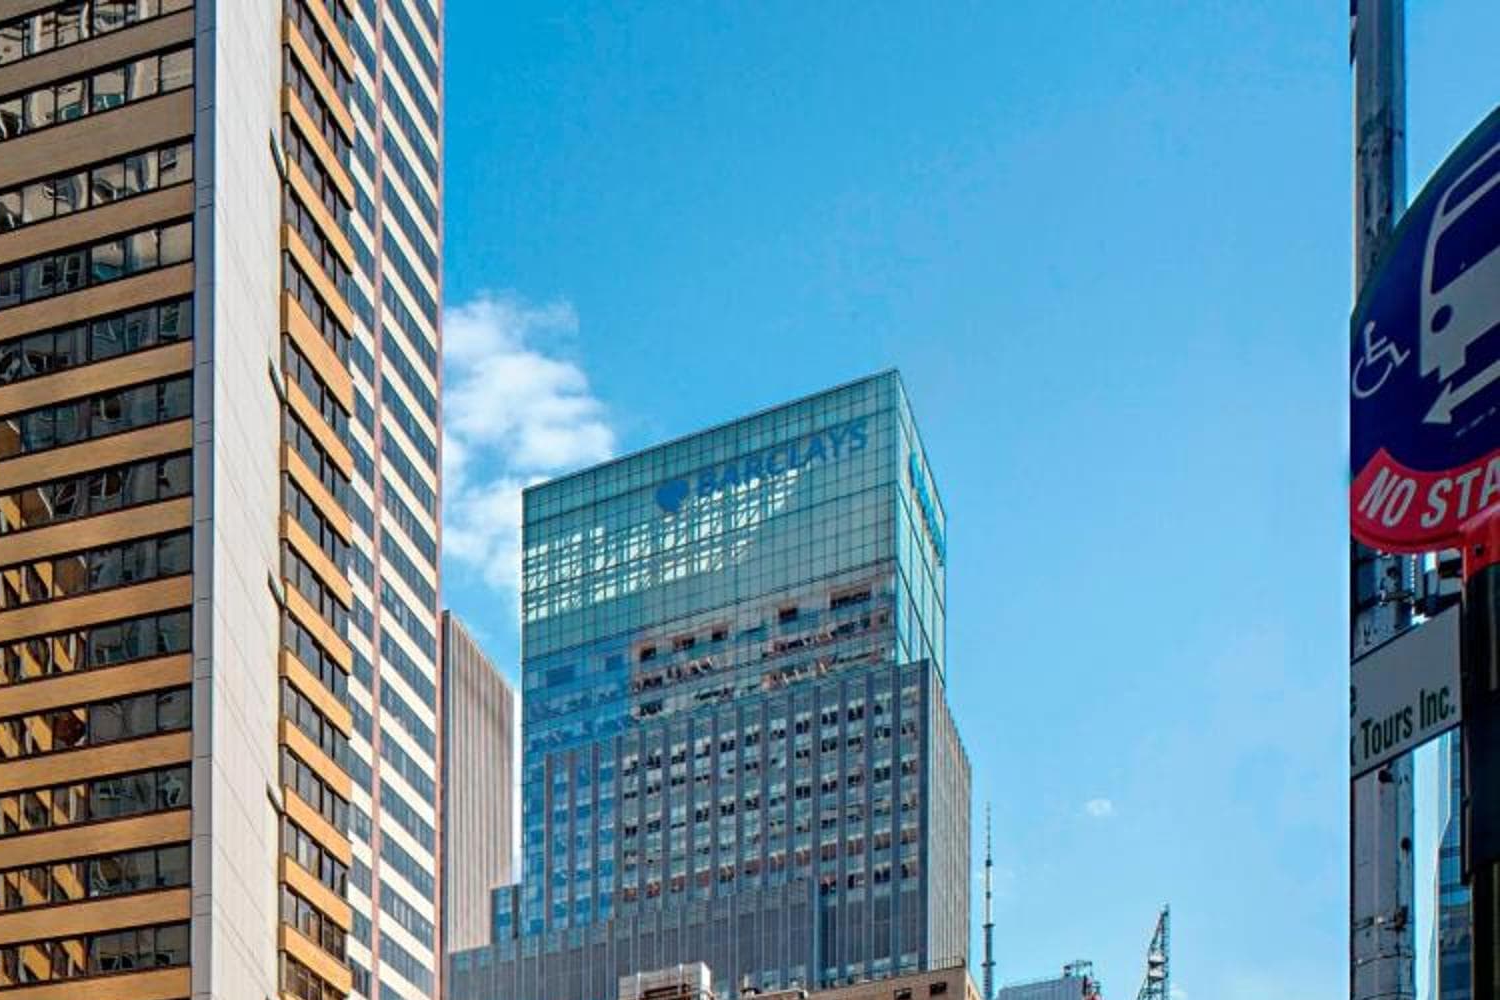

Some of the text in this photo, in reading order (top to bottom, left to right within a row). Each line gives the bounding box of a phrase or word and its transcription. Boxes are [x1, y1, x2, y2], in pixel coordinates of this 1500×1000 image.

[697, 419, 868, 493] BARCLAYS
[1357, 466, 1418, 528] NO
[1361, 706, 1413, 760] Tours
[1419, 686, 1456, 731] Inc.
